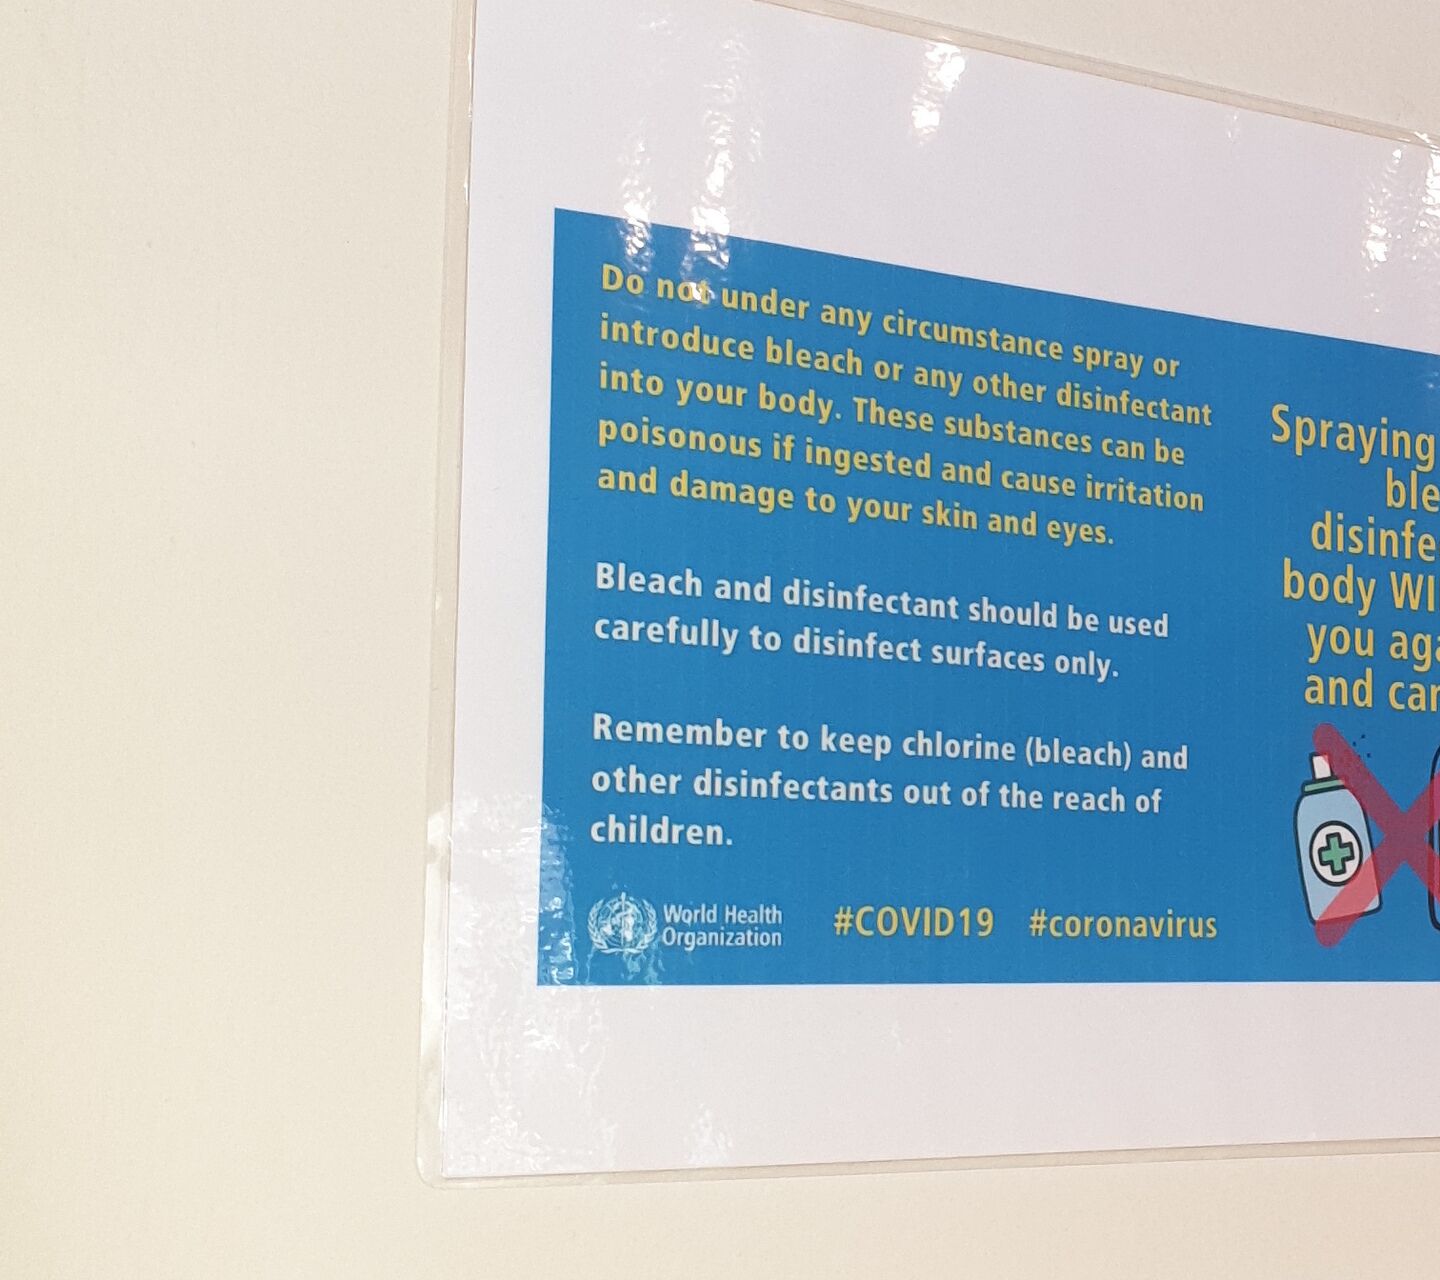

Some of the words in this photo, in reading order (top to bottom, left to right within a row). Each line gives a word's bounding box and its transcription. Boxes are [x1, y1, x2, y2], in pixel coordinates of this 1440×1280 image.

[602, 263, 645, 295] Do
[657, 277, 711, 305] not
[722, 288, 810, 319] under
[821, 305, 872, 336] any
[883, 309, 1063, 360] circumstance
[1073, 345, 1143, 378] spray
[1153, 358, 1179, 377] or
[1272, 404, 1435, 472] Spraying
[596, 562, 702, 597] Bleach
[715, 576, 771, 603] and
[783, 578, 959, 619] disinfectant
[969, 597, 1057, 628] should
[1068, 605, 1099, 631] be
[1109, 613, 1168, 637] used
[1284, 557, 1376, 616] body
[1307, 623, 1373, 663] you
[1305, 667, 1372, 707] and
[591, 814, 732, 845] children.
[663, 903, 717, 925] World
[725, 904, 783, 925] Health
[834, 906, 993, 936] #COVID19
[1029, 909, 1217, 938] #coronavirus
[661, 926, 782, 951] Organization
